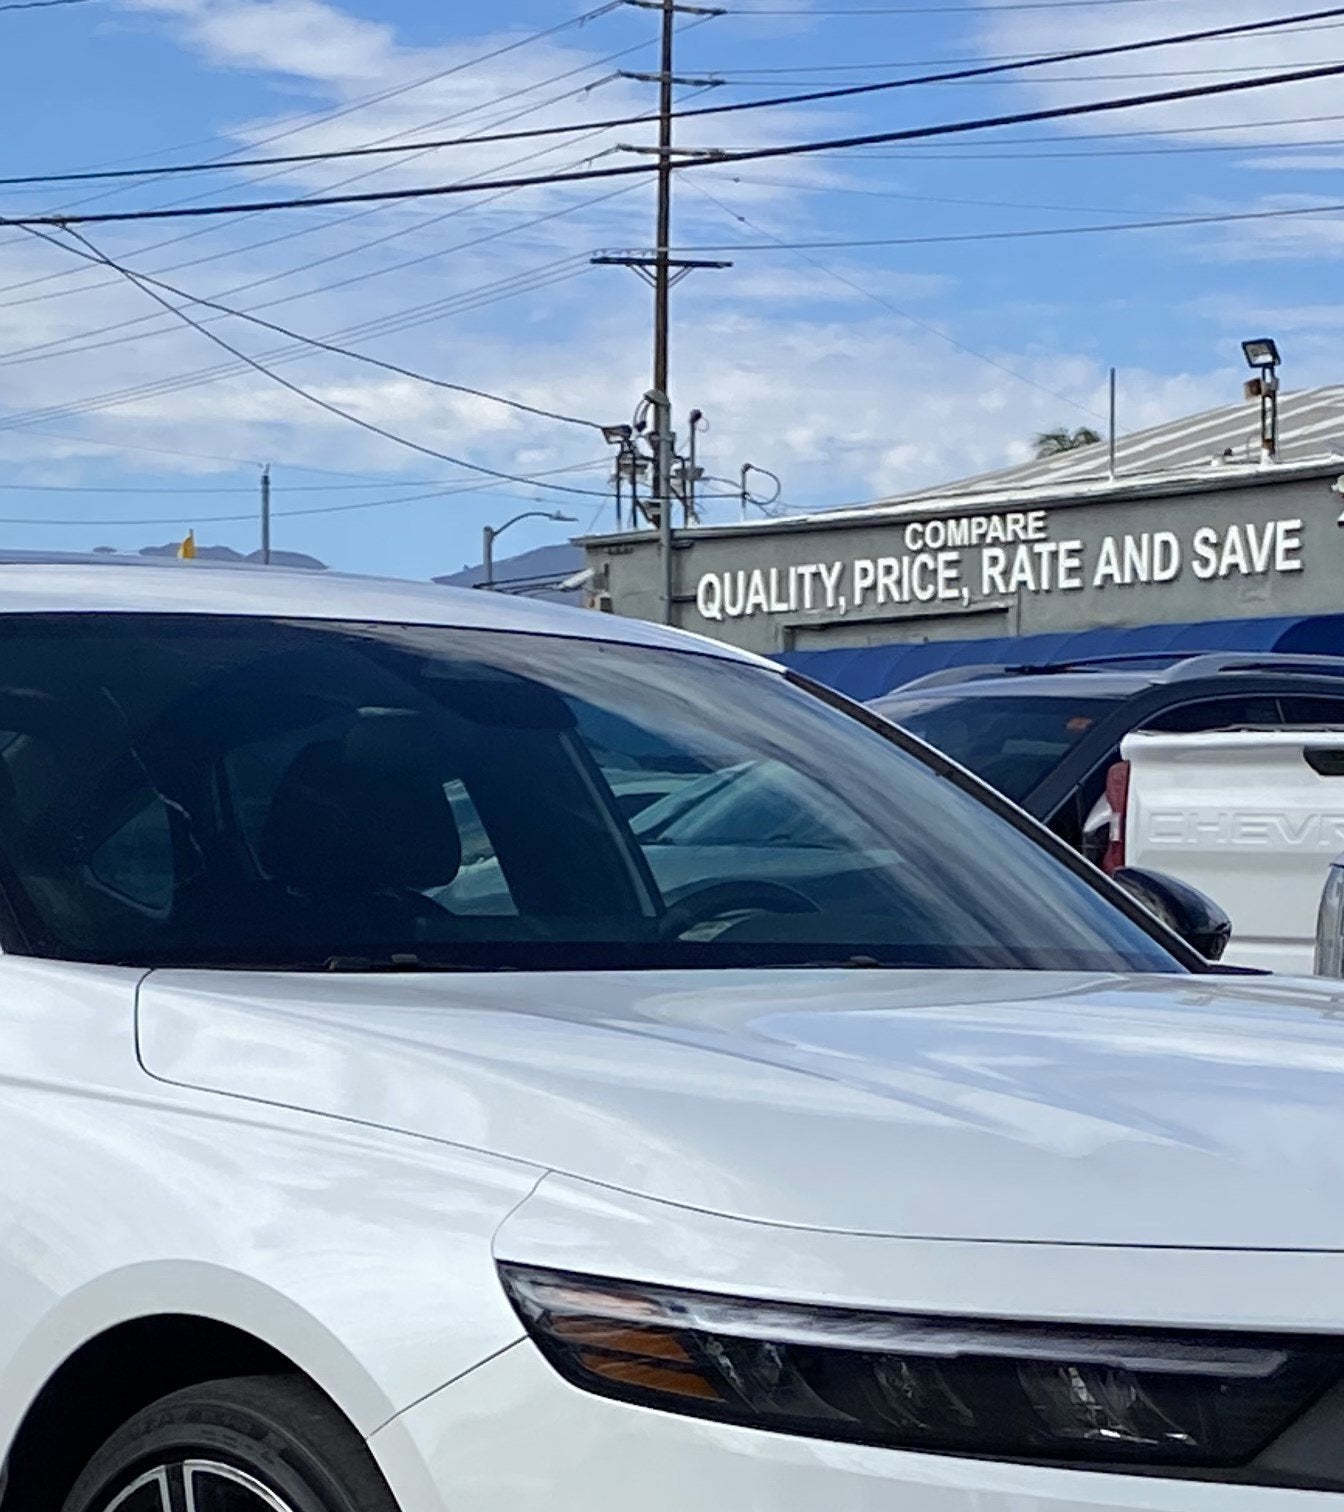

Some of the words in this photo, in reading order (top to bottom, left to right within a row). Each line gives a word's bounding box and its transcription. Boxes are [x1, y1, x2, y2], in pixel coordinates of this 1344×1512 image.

[905, 510, 1047, 551] COMPARE
[696, 561, 847, 621] QUALITY,
[854, 551, 970, 606] PRICE,
[982, 540, 1084, 596] RATE
[1093, 531, 1181, 587] AND
[1192, 519, 1303, 579] SAVE
